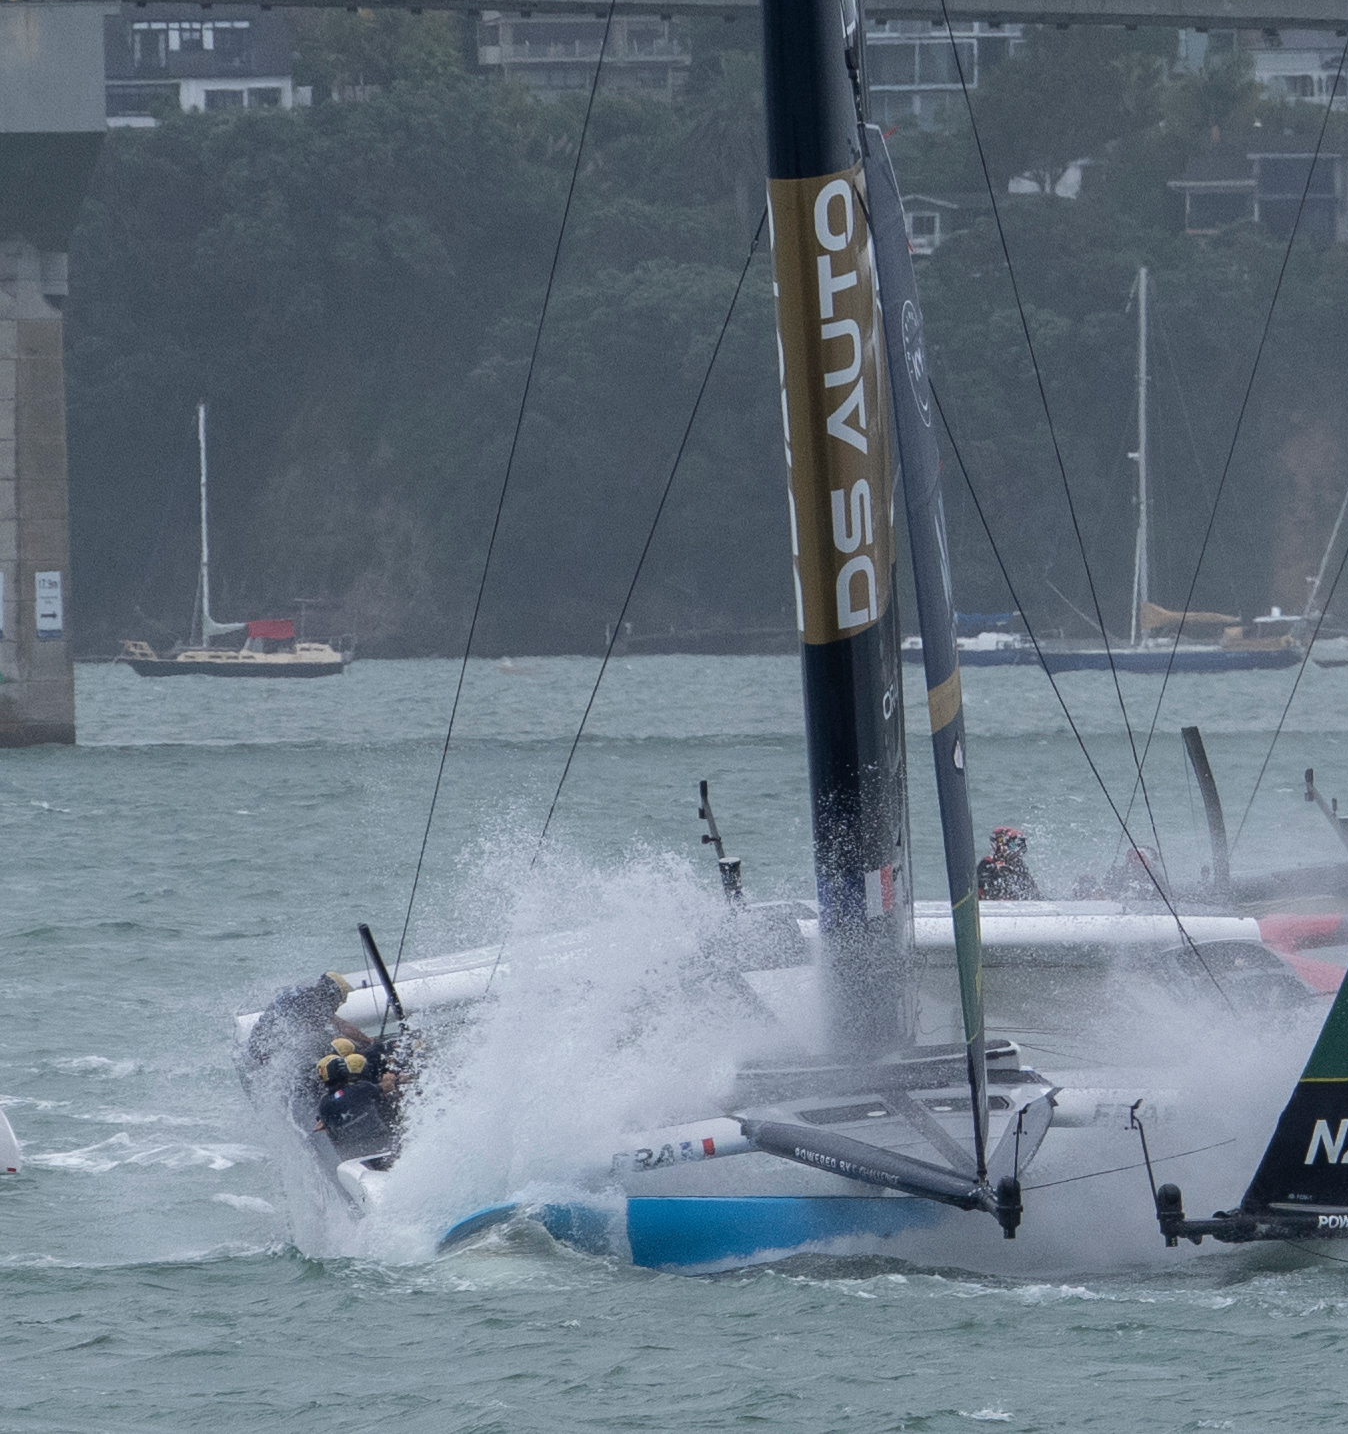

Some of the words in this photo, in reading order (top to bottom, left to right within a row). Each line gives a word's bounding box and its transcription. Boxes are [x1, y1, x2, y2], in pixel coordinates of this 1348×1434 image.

[814, 178, 868, 454] AUTO
[831, 478, 878, 629] DS
[795, 1147, 836, 1168] POWERED
[839, 1160, 851, 1172] BY
